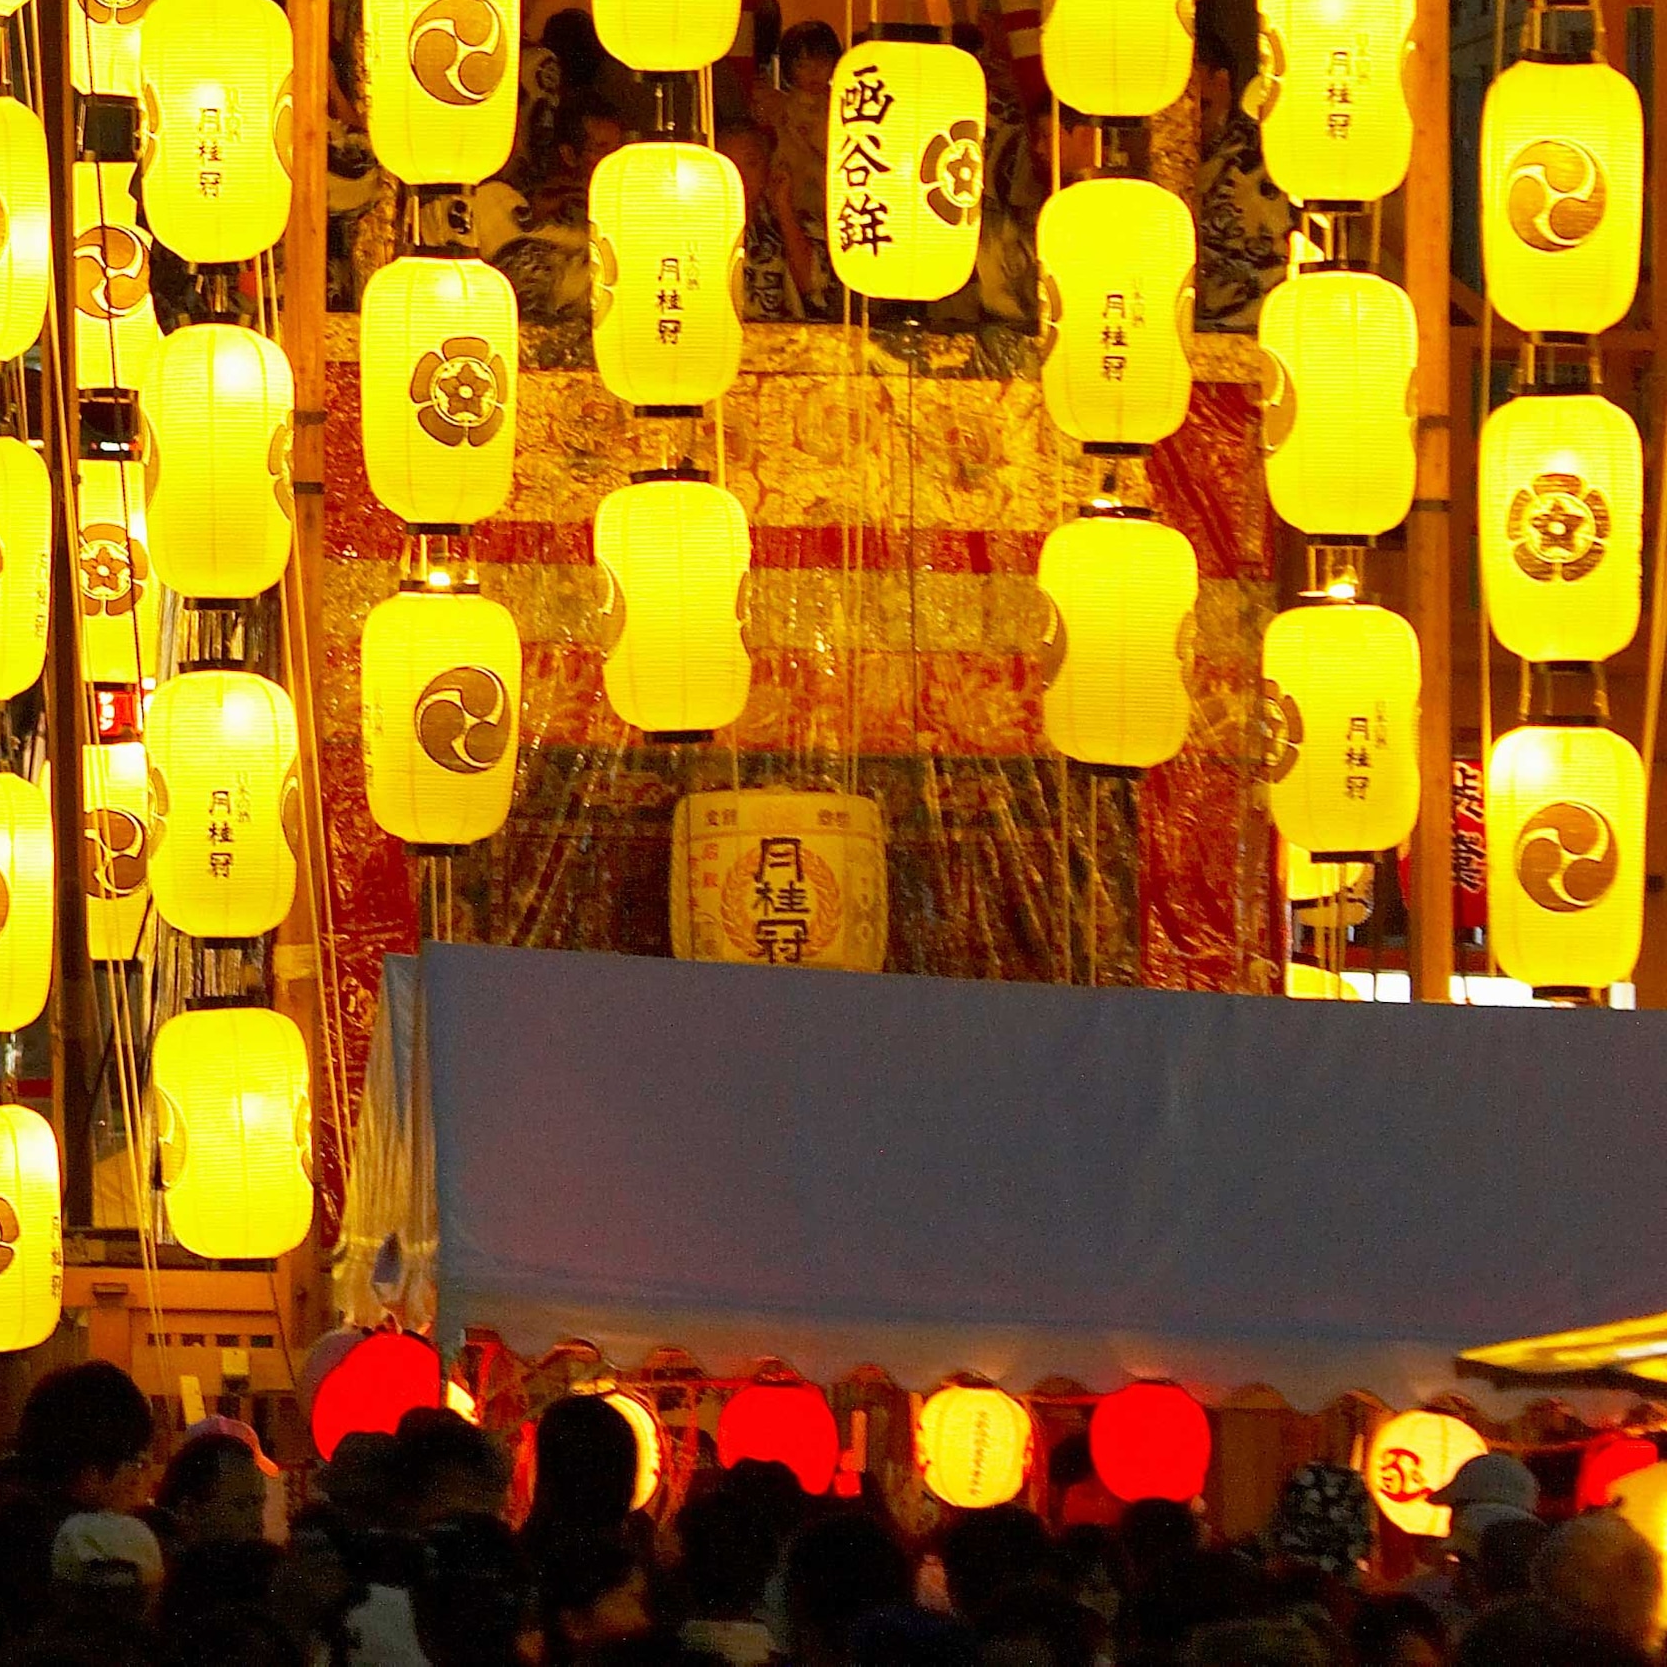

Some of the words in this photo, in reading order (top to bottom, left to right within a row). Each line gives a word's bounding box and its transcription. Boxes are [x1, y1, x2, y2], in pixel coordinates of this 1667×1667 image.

[196, 105, 225, 202] 月桂冠
[655, 257, 683, 347] 月桂冠
[1101, 293, 1129, 382] 月桂冠
[1344, 715, 1372, 801] 月桂冠
[207, 790, 236, 880] 月桂冠
[753, 837, 811, 965] 月桂冠
